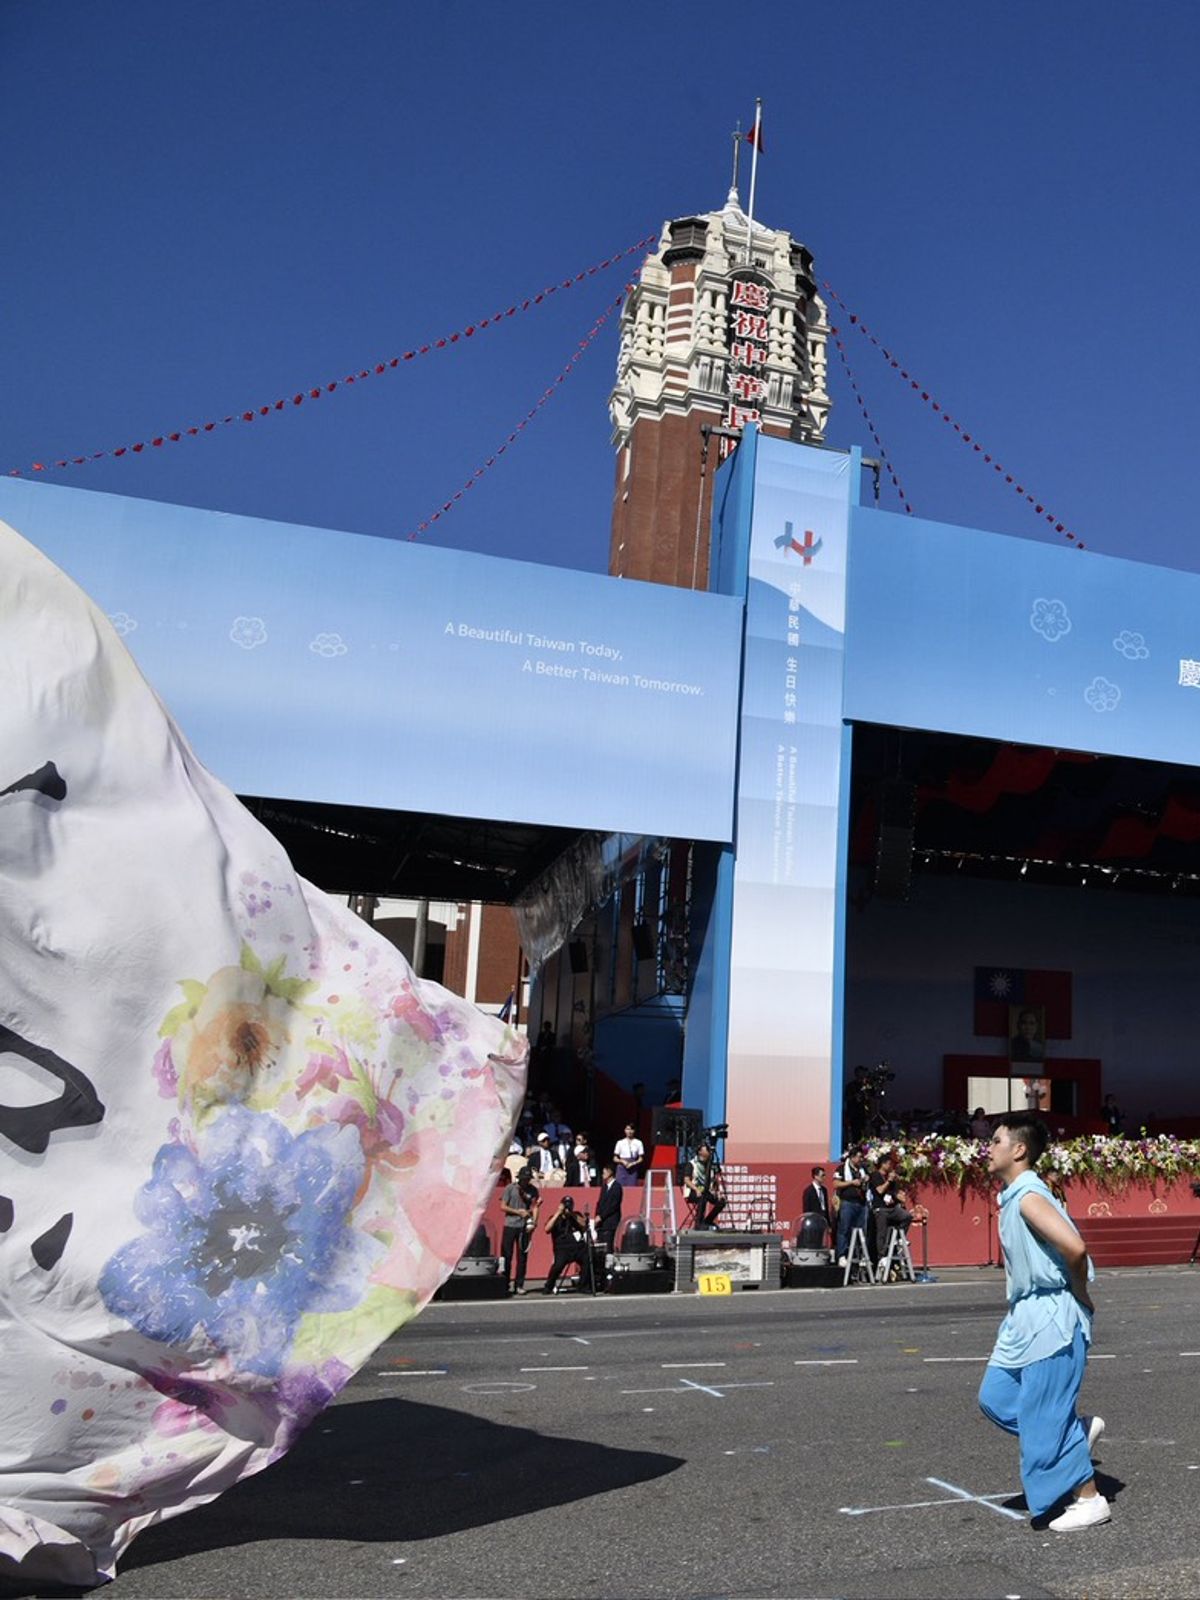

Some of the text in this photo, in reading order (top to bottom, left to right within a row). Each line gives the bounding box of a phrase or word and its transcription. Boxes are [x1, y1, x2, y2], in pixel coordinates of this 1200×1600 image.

[721, 280, 769, 459] 慶祝中華民
[445, 621, 624, 661] A Beautiful Taiwan Today,
[522, 660, 705, 697] A Better Taiwan Tomorrow.
[784, 656, 798, 724] 生日快樂
[705, 1277, 726, 1292] 15
